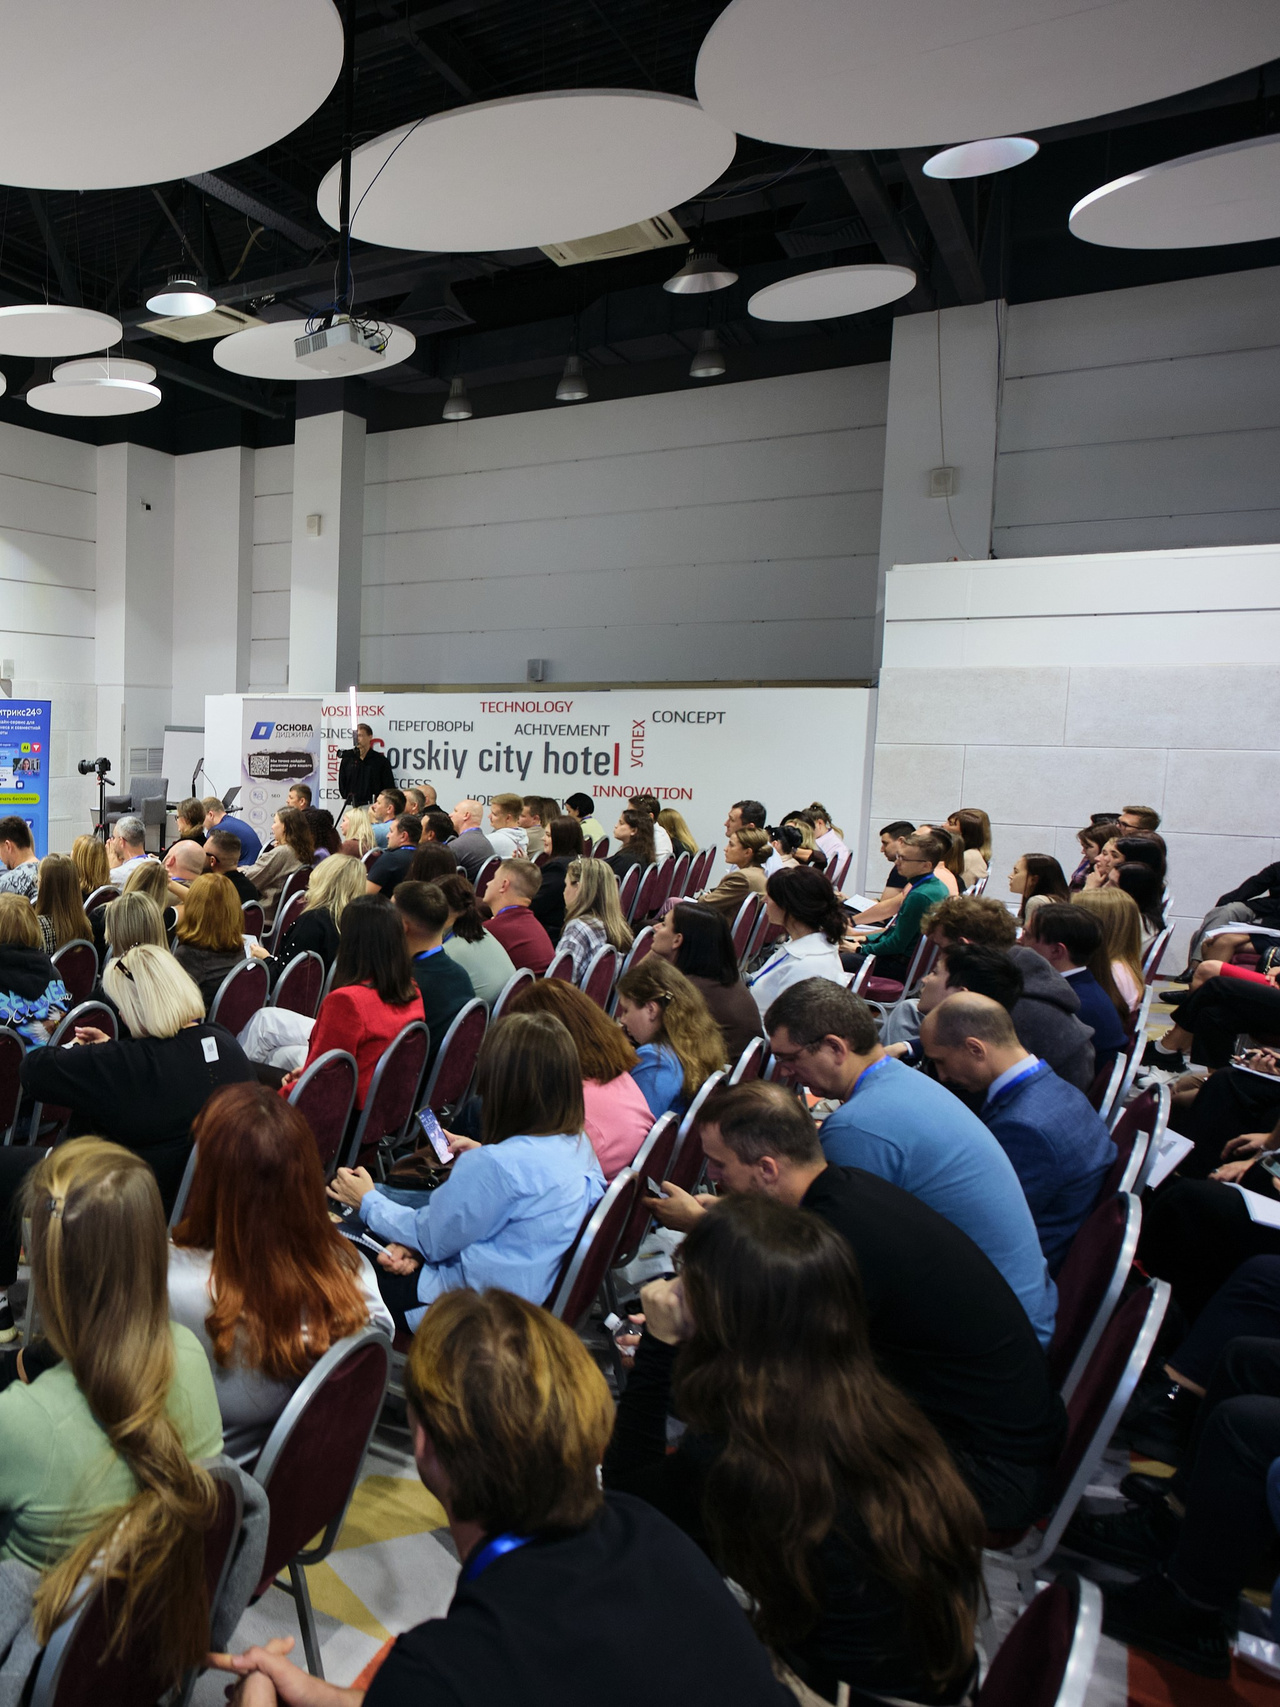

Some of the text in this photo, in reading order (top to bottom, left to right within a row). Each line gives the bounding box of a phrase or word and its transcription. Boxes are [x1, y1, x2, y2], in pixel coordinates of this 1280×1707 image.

[322, 706, 385, 716] VOSIIRSK
[480, 700, 573, 713] TECHNOLOGY
[652, 710, 726, 724] CONCEPT
[276, 724, 314, 732] ОСНОВА
[388, 720, 474, 732] ПЕРЕГОВОРЫ
[514, 723, 610, 737] ACHIVEMENT
[630, 720, 646, 768] УСПЕХ
[328, 744, 338, 781] ИДЕЯ
[478, 742, 532, 781] city
[544, 742, 620, 776] hotel
[592, 785, 693, 800] INNOVATION
